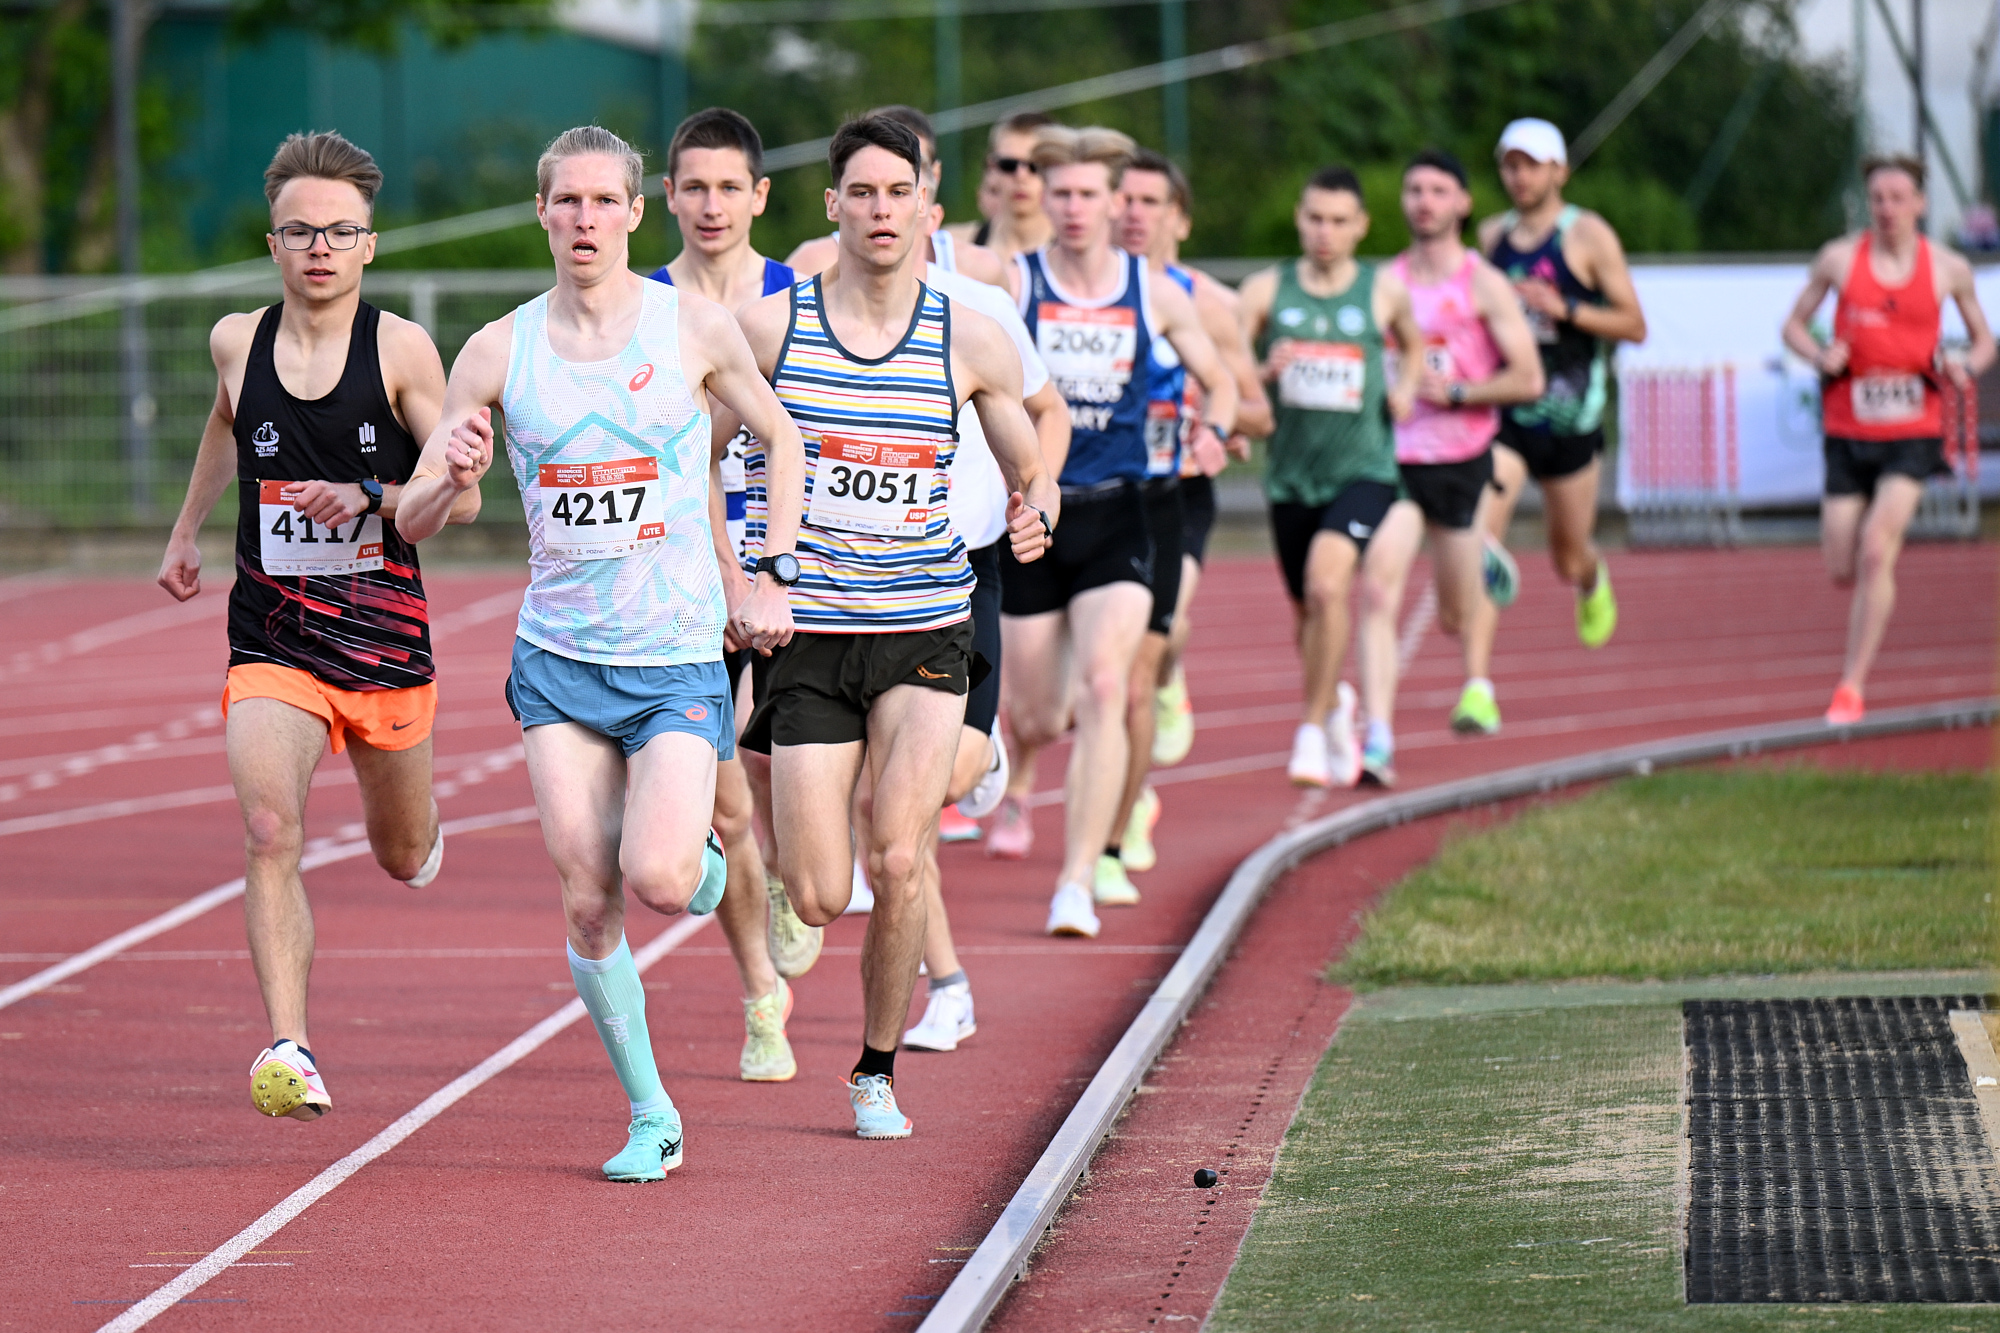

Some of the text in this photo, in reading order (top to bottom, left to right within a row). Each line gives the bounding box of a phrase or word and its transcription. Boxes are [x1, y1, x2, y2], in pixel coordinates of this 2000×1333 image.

[1051, 327, 1123, 356] 2067
[266, 445, 279, 453] AGH
[361, 445, 377, 453] AGH
[827, 465, 918, 504] 3051
[551, 486, 646, 526] 4217
[909, 512, 926, 520] USP
[643, 526, 661, 536] UTE
[362, 546, 379, 556] UTE
